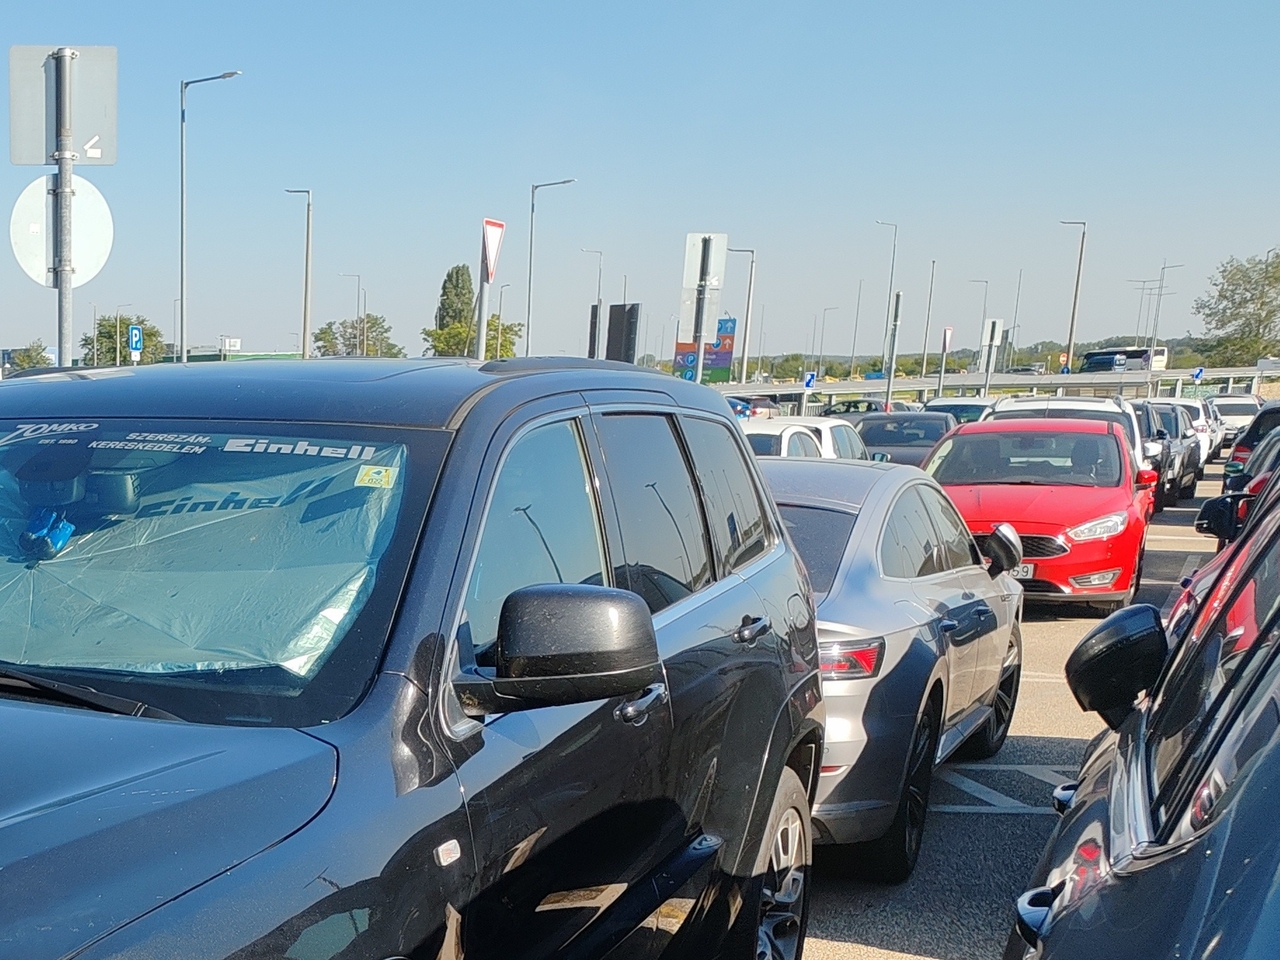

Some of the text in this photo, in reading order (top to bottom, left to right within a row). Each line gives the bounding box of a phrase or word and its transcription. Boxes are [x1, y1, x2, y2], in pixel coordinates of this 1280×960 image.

[126, 432, 212, 444] SZERSZÁM-
[87, 440, 207, 455] KERESKEDELEM
[223, 438, 376, 460] Einhell
